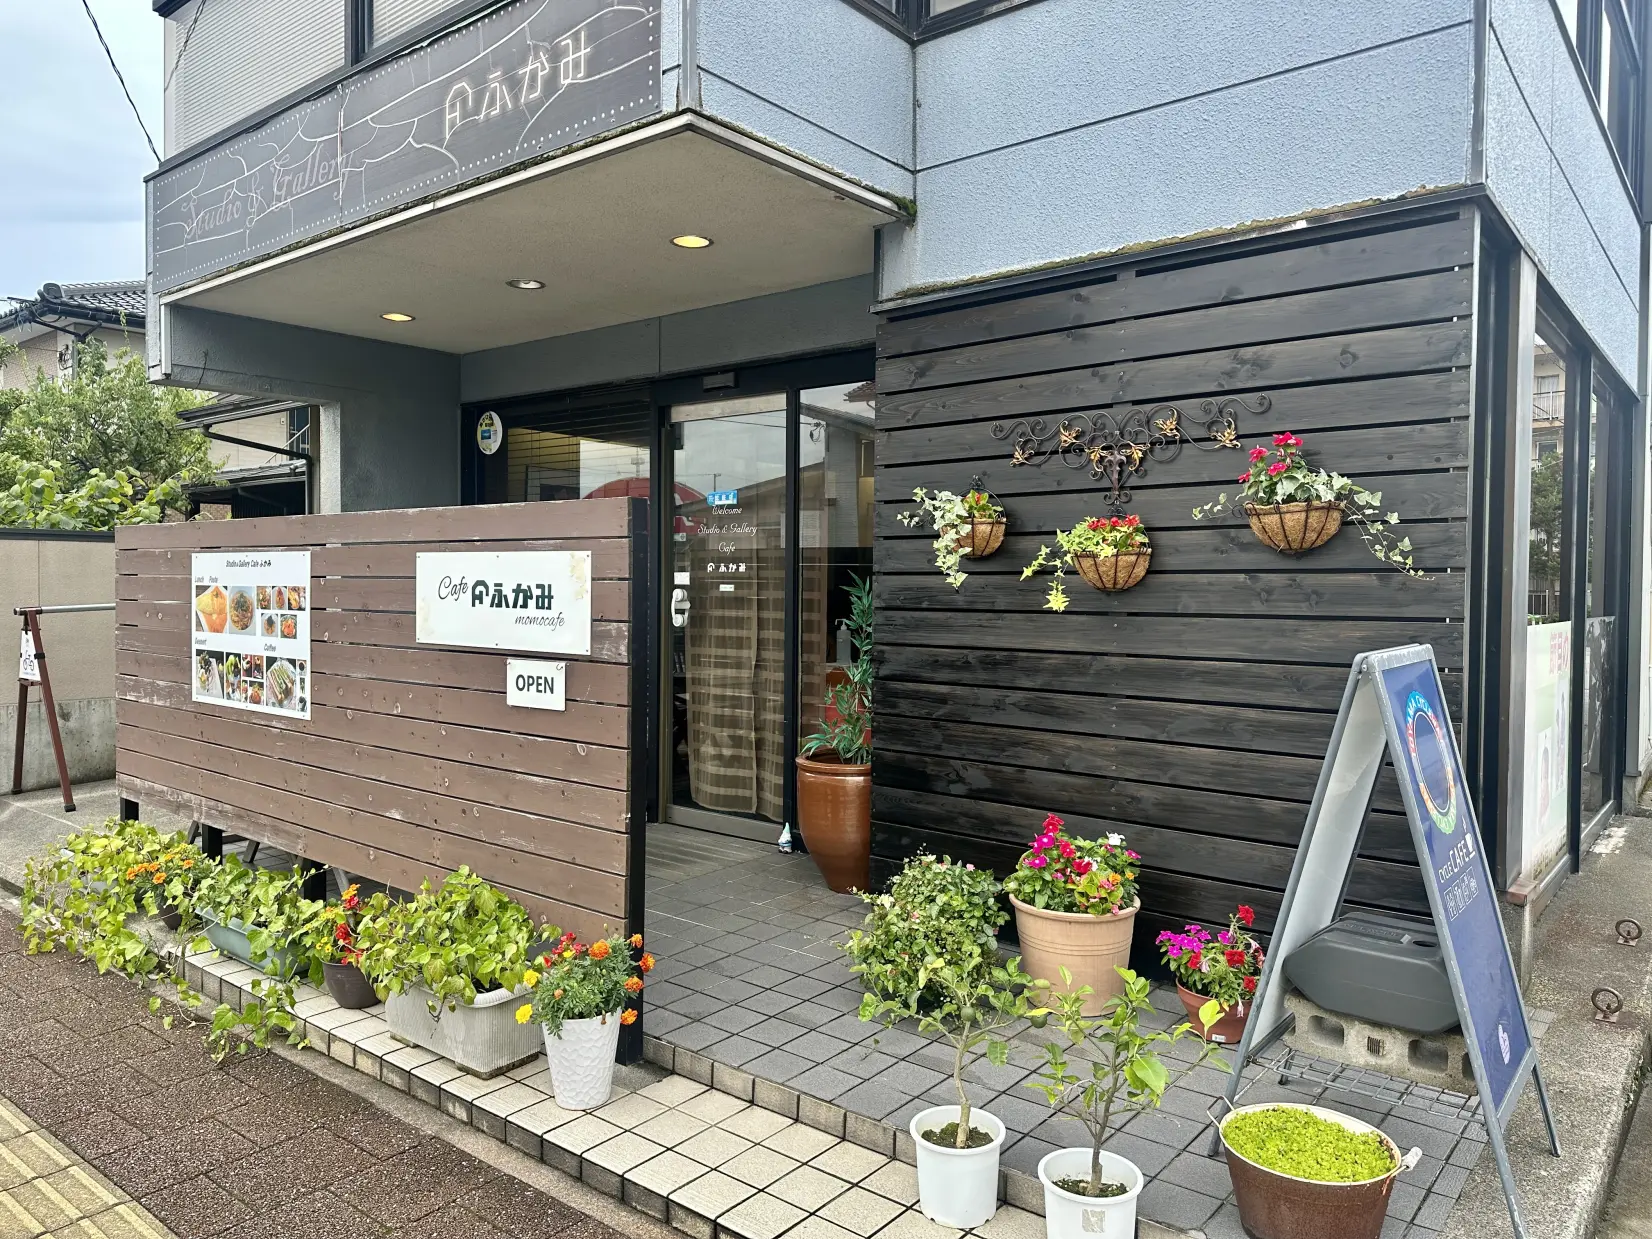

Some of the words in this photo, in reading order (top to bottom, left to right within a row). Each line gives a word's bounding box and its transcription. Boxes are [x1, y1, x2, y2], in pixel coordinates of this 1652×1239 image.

[712, 505, 742, 514] Welcome
[698, 523, 720, 534] Studio
[722, 524, 728, 533] &
[730, 522, 757, 536] Gallery
[718, 541, 735, 555] Cafe
[438, 576, 468, 601] Cafe
[515, 612, 565, 631] momocafe
[515, 674, 554, 695] OPEN
